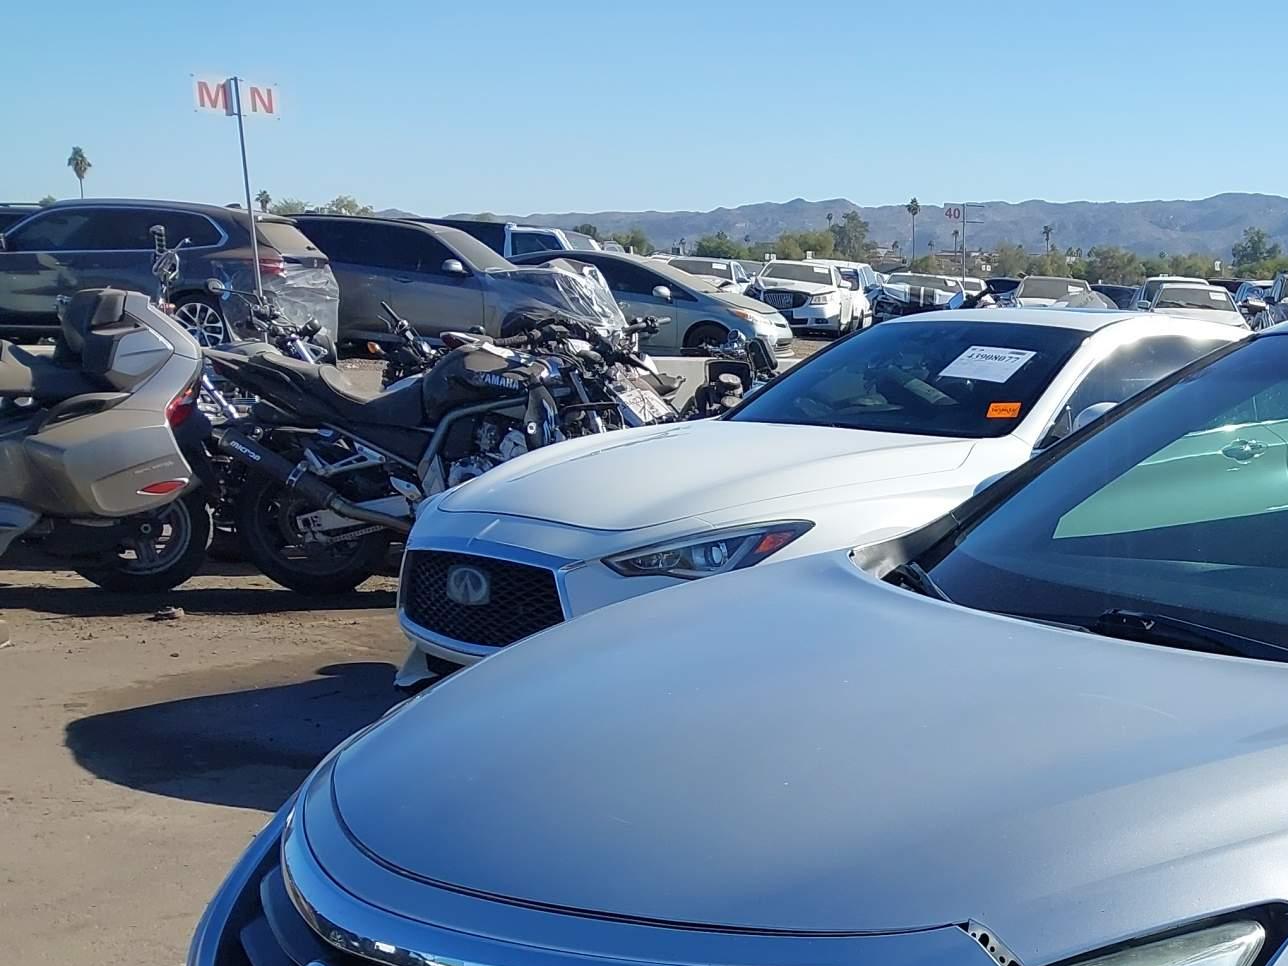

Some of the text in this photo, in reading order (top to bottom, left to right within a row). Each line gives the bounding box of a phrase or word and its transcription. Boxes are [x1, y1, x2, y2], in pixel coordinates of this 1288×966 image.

[198, 80, 229, 110] M
[250, 87, 274, 114] N
[944, 207, 961, 220] 40
[480, 373, 519, 391] YAMAHA
